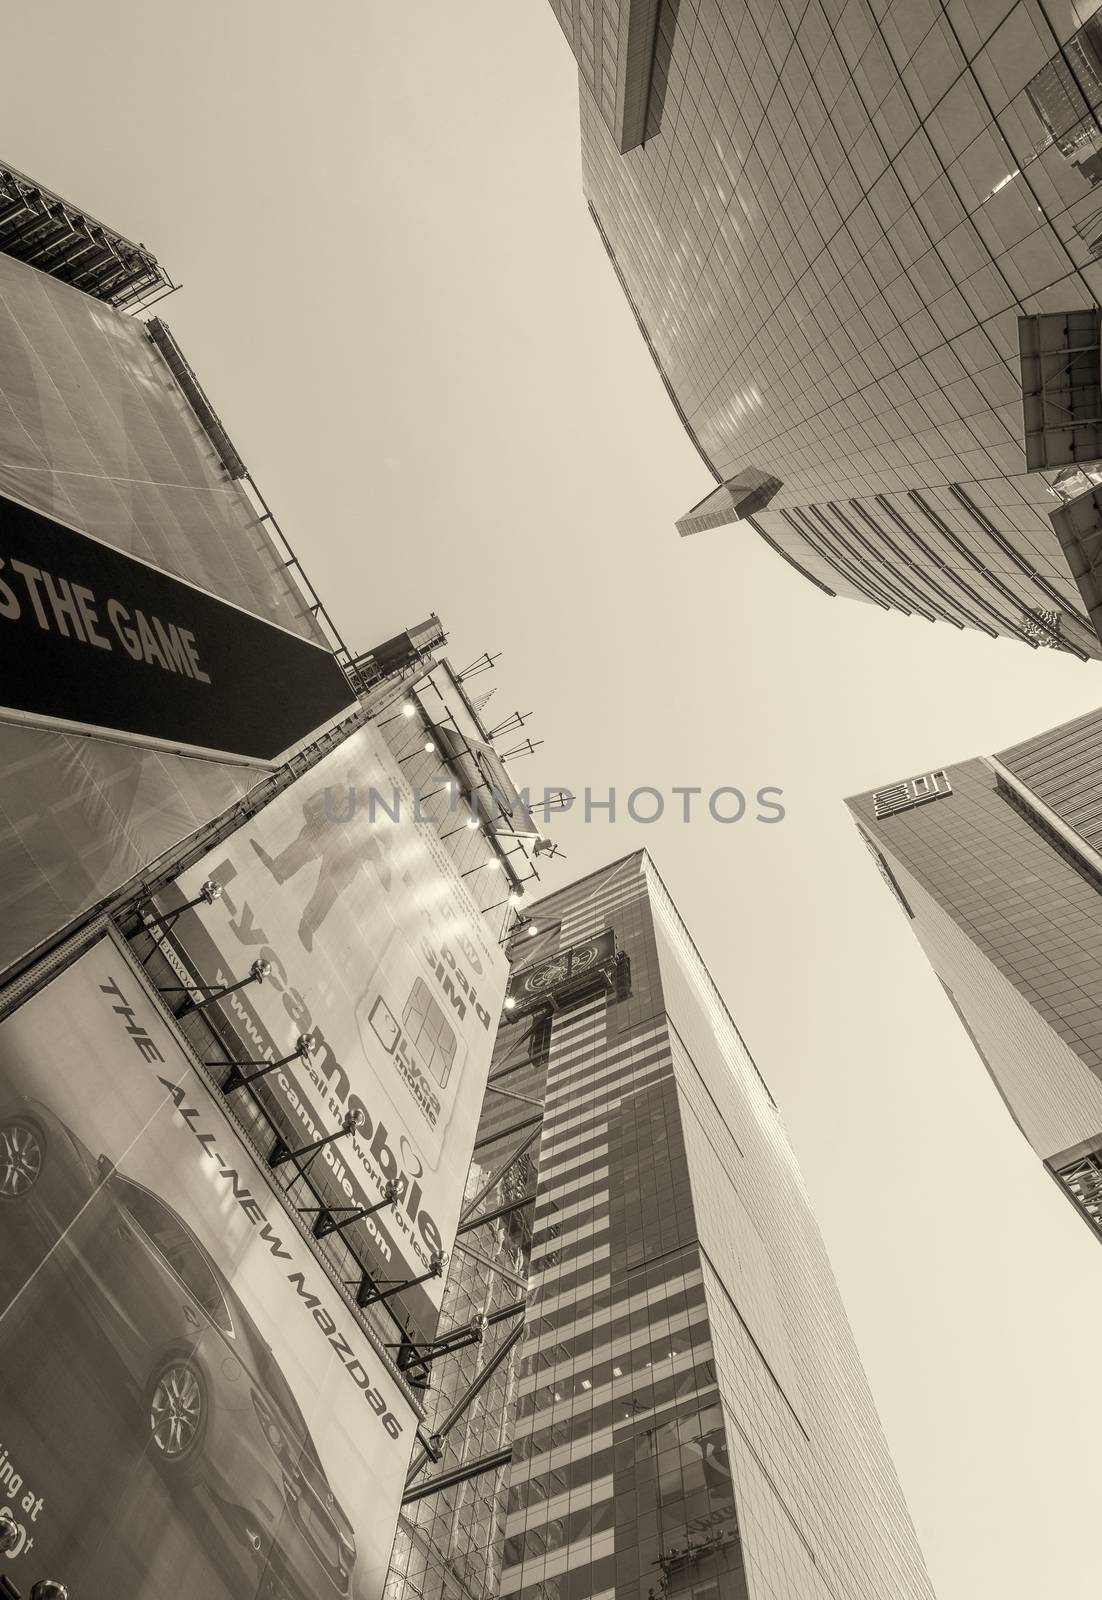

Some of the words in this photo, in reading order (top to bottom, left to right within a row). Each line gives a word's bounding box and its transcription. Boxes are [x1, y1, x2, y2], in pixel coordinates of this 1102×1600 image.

[10, 558, 112, 651] THE
[107, 598, 211, 684] GAME
[99, 976, 166, 1064] THE
[157, 1075, 293, 1261] ALL-NEW
[394, 1053, 437, 1126] mobile
[21, 1491, 44, 1522] at
